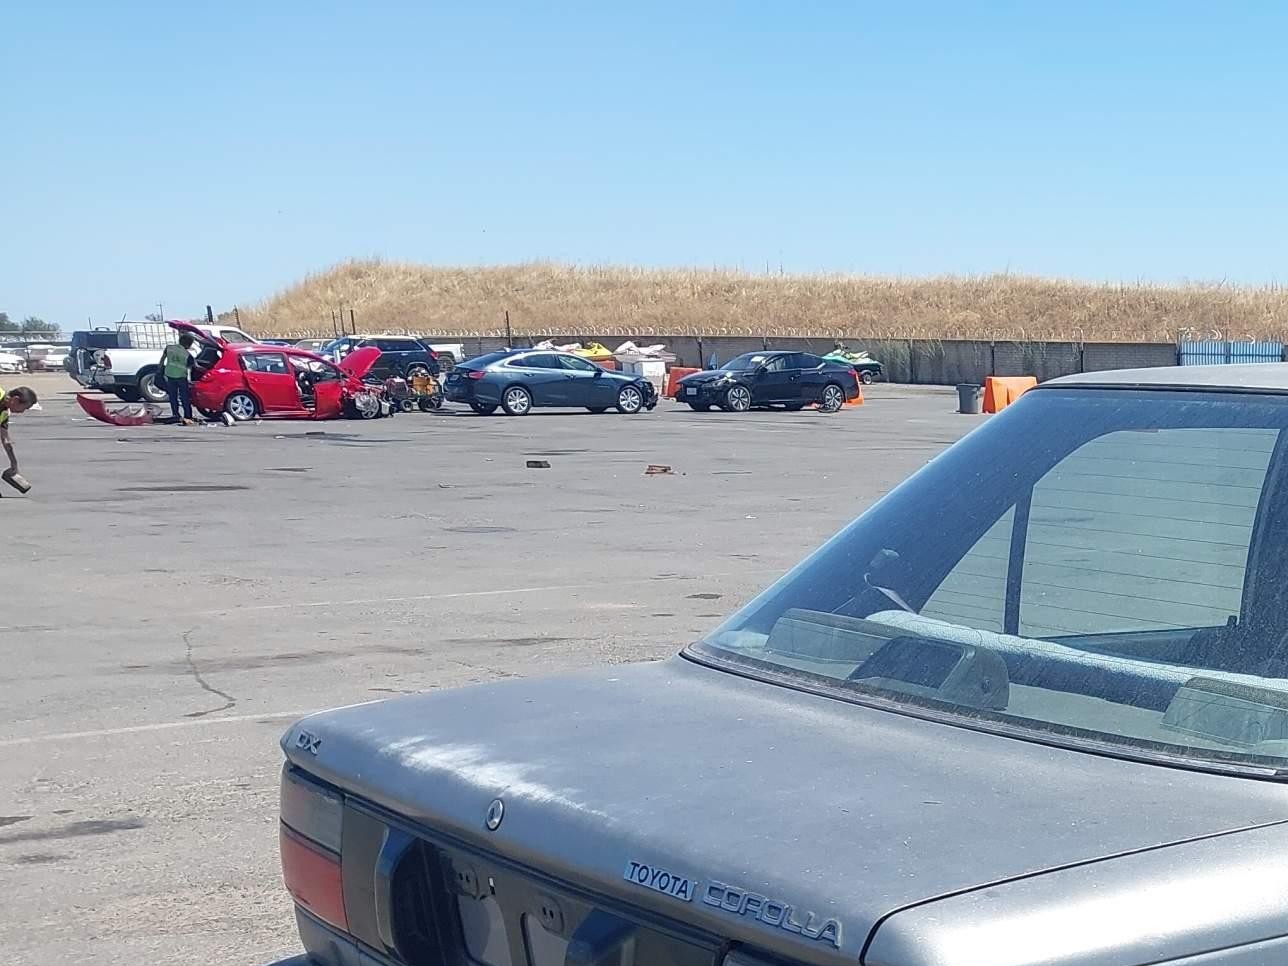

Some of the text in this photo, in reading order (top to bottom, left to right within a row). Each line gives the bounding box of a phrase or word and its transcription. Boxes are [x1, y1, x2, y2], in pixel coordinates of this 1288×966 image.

[296, 730, 321, 754] DX
[628, 861, 842, 949] TOYOTA COROLLA
